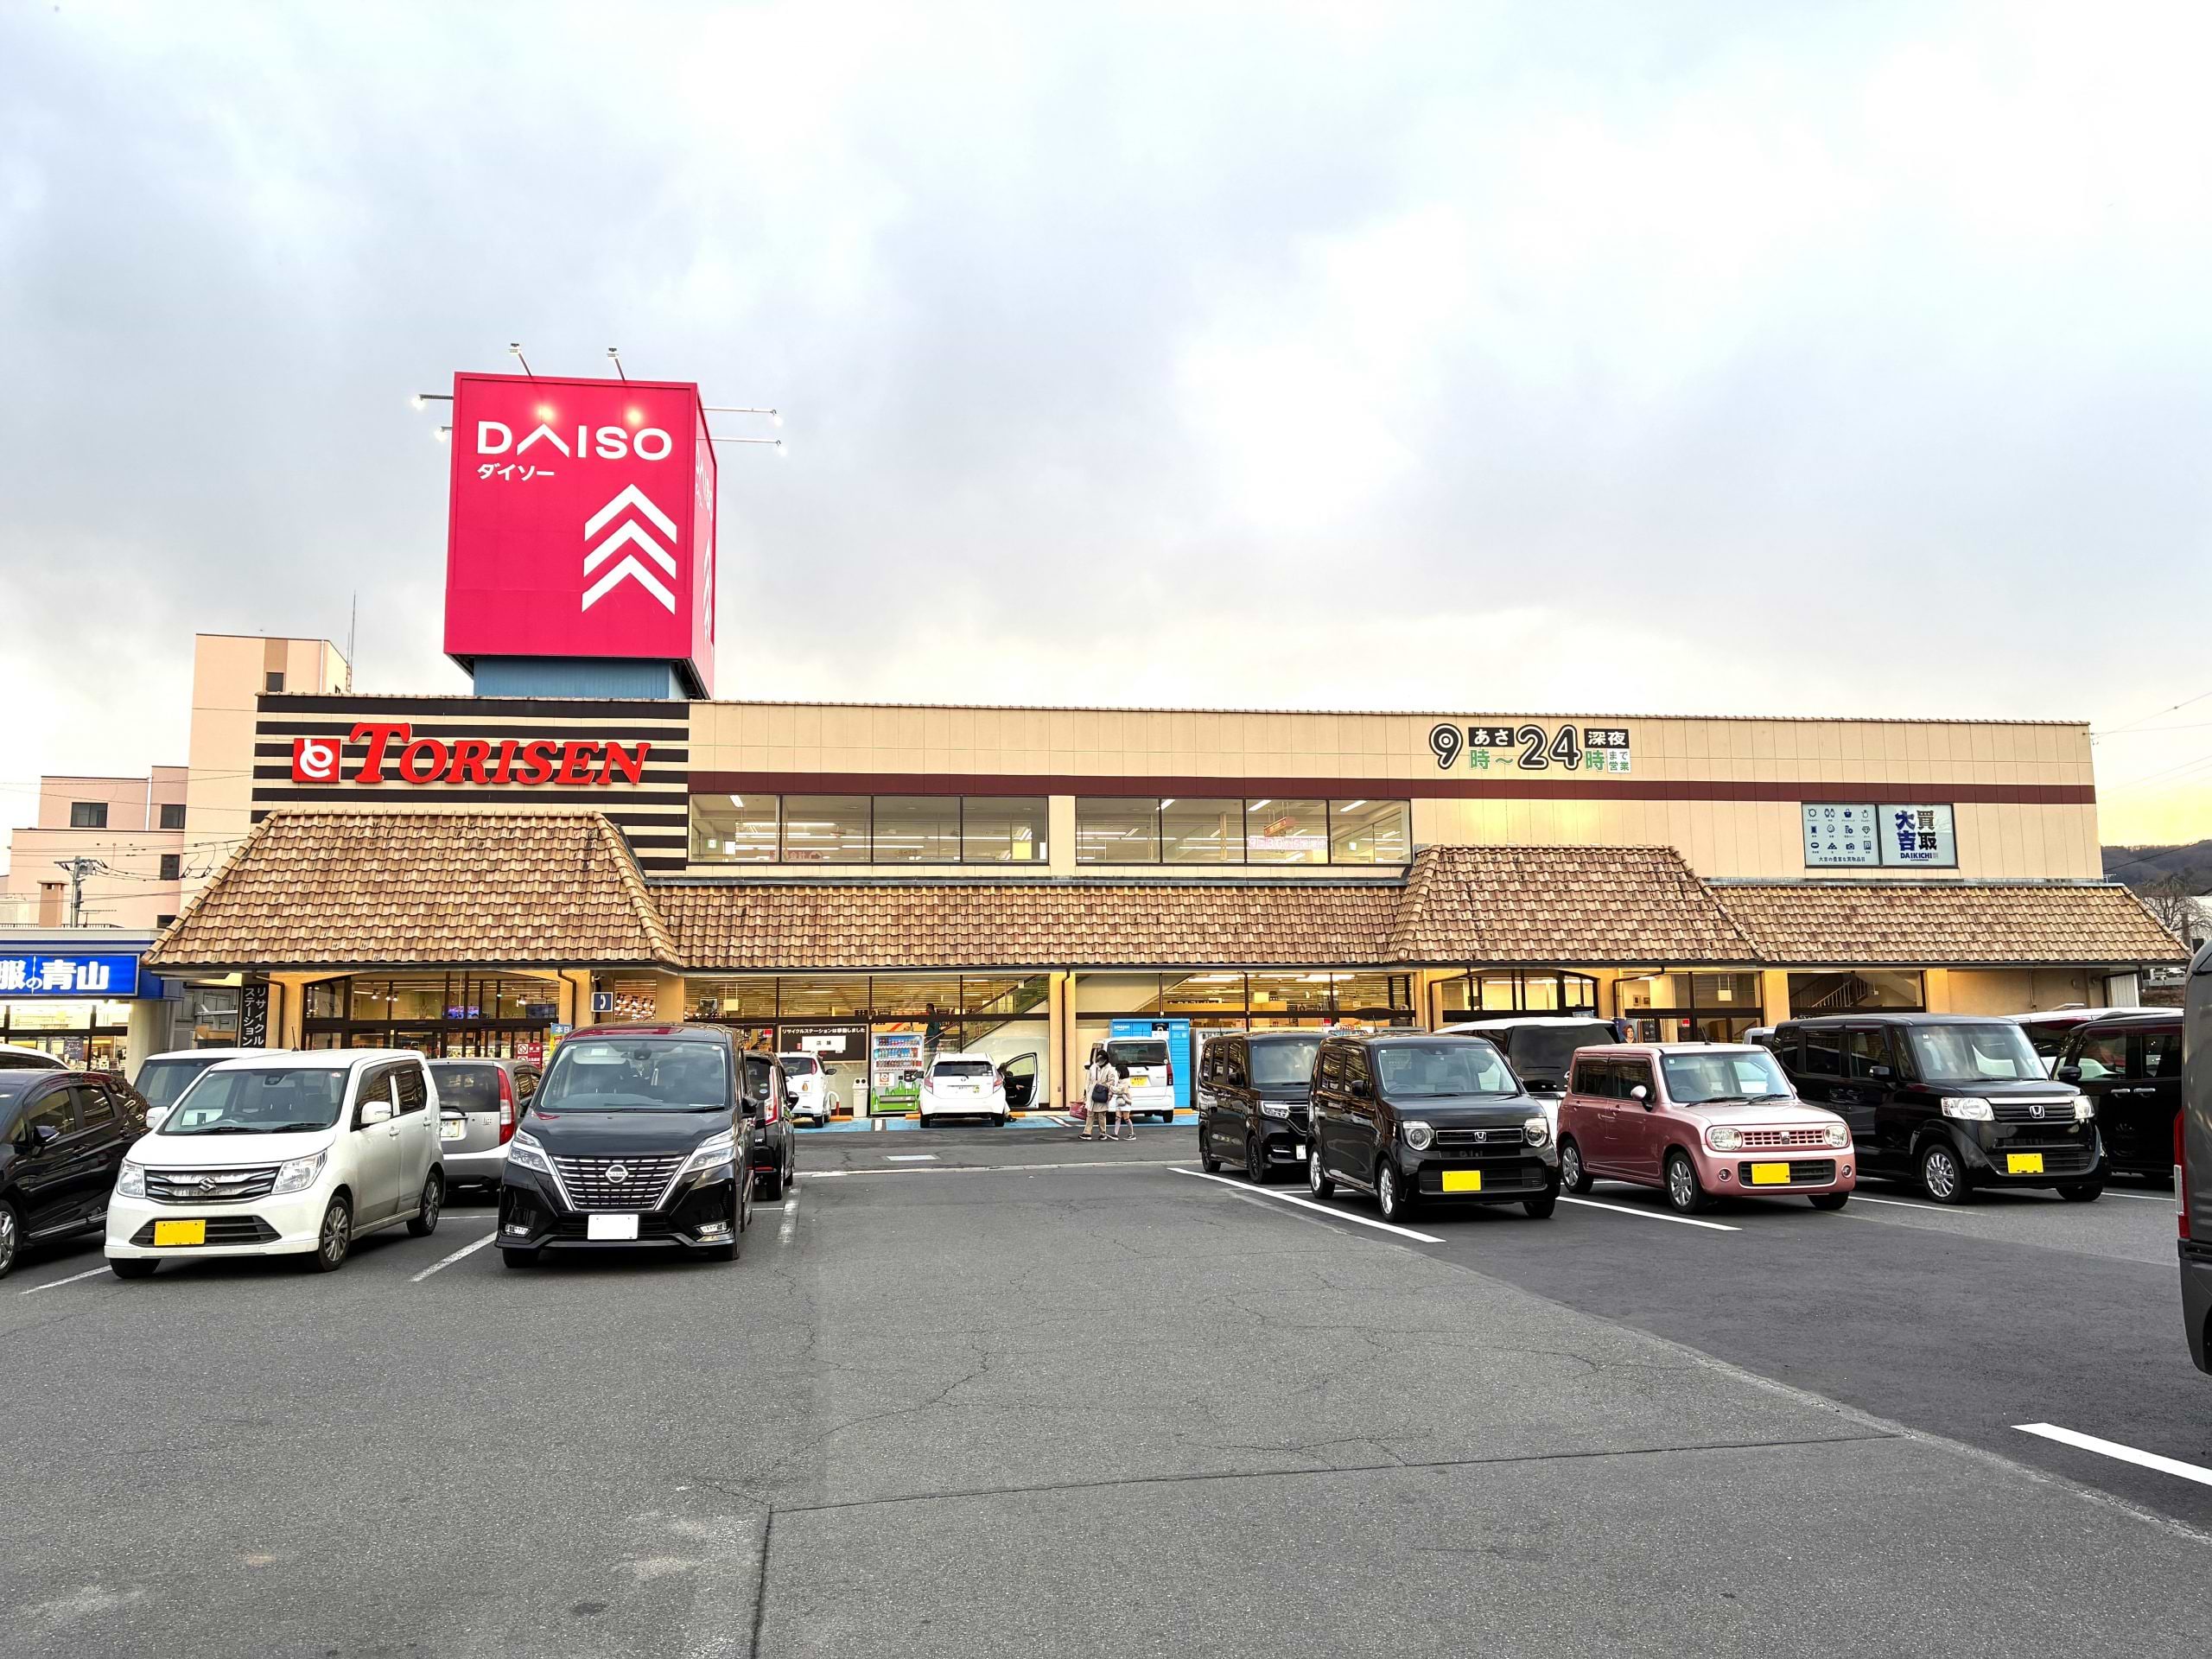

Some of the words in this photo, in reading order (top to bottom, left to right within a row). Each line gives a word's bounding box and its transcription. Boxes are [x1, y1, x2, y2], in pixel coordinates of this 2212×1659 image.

[477, 421, 672, 461] DAISO
[477, 463, 555, 480] ダイソー
[1429, 723, 1463, 770] 9
[1474, 728, 1510, 746] あさ
[1516, 724, 1582, 770] 24
[1588, 730, 1626, 746] 深夜
[349, 722, 652, 785] TORISEN
[1585, 750, 1605, 771] 時
[1609, 751, 1628, 760] まで
[1609, 761, 1629, 772] 営業
[243, 988, 256, 1046] ステーション
[252, 987, 267, 1046] リサイクル
